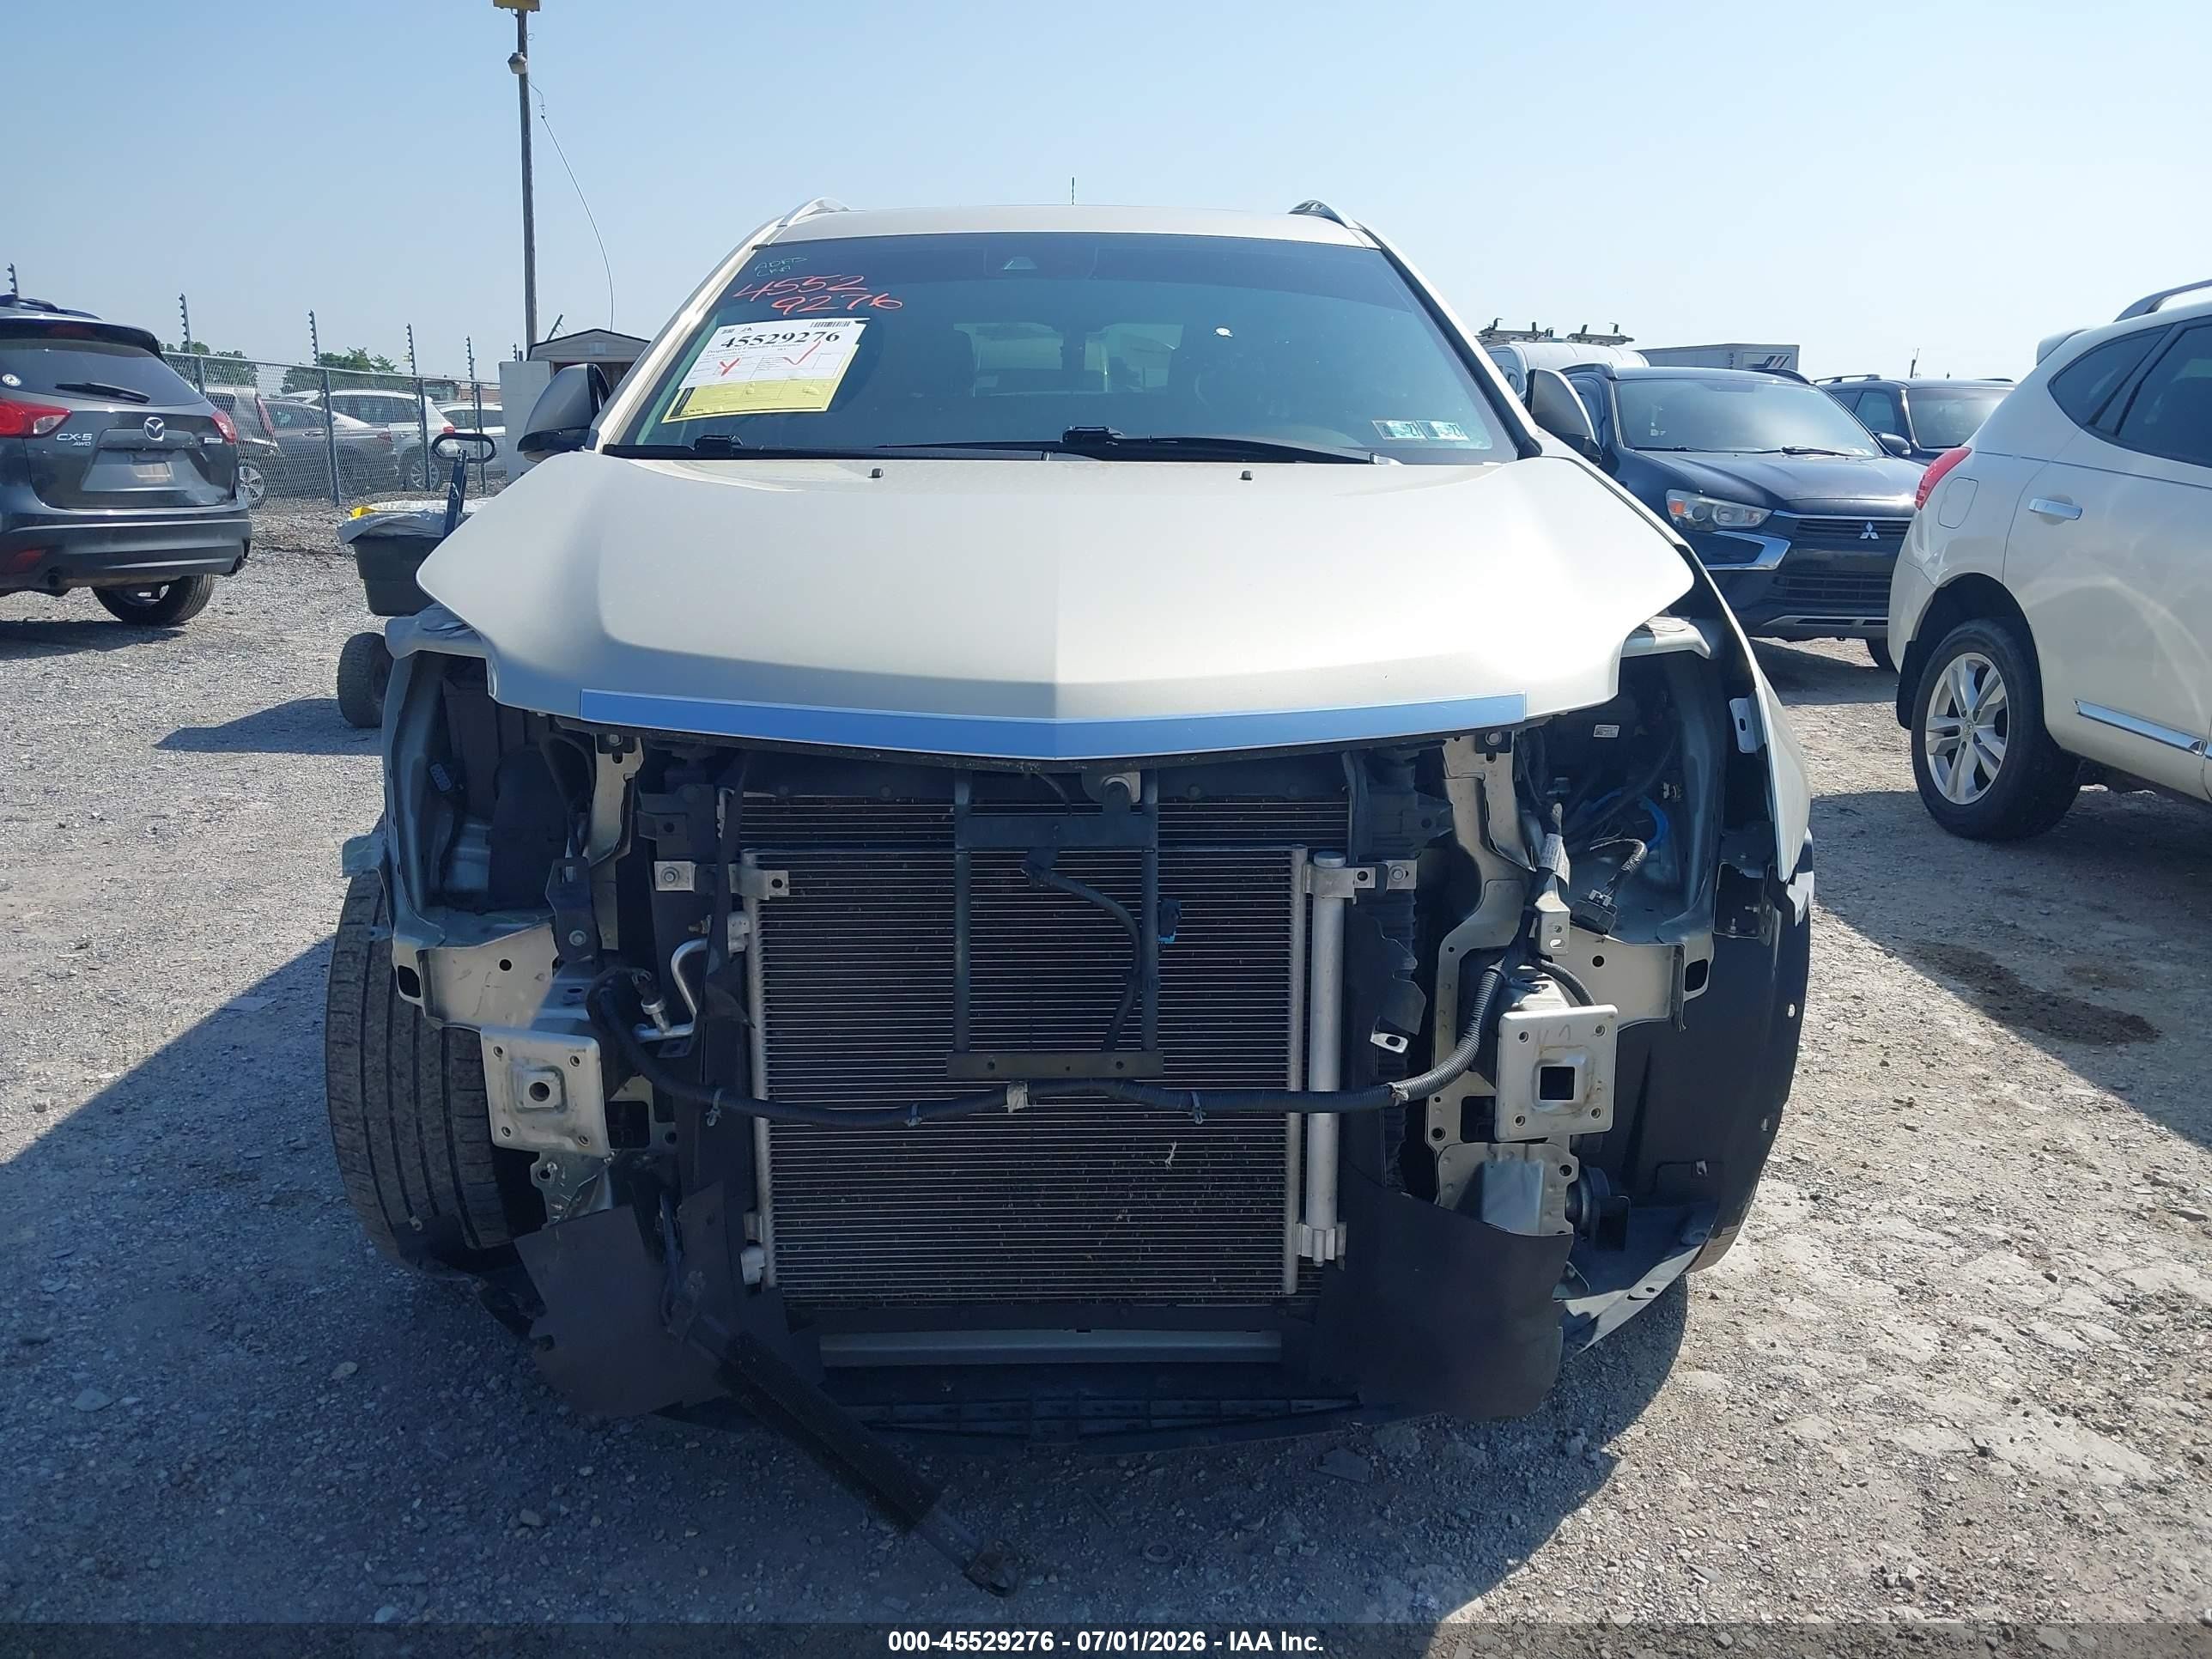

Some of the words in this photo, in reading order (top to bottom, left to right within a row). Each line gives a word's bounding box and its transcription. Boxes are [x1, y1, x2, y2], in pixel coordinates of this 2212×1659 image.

[732, 274, 868, 302] 4552
[770, 293, 903, 316] 9276
[720, 331, 841, 349] 45529276
[56, 433, 93, 441] CX-5
